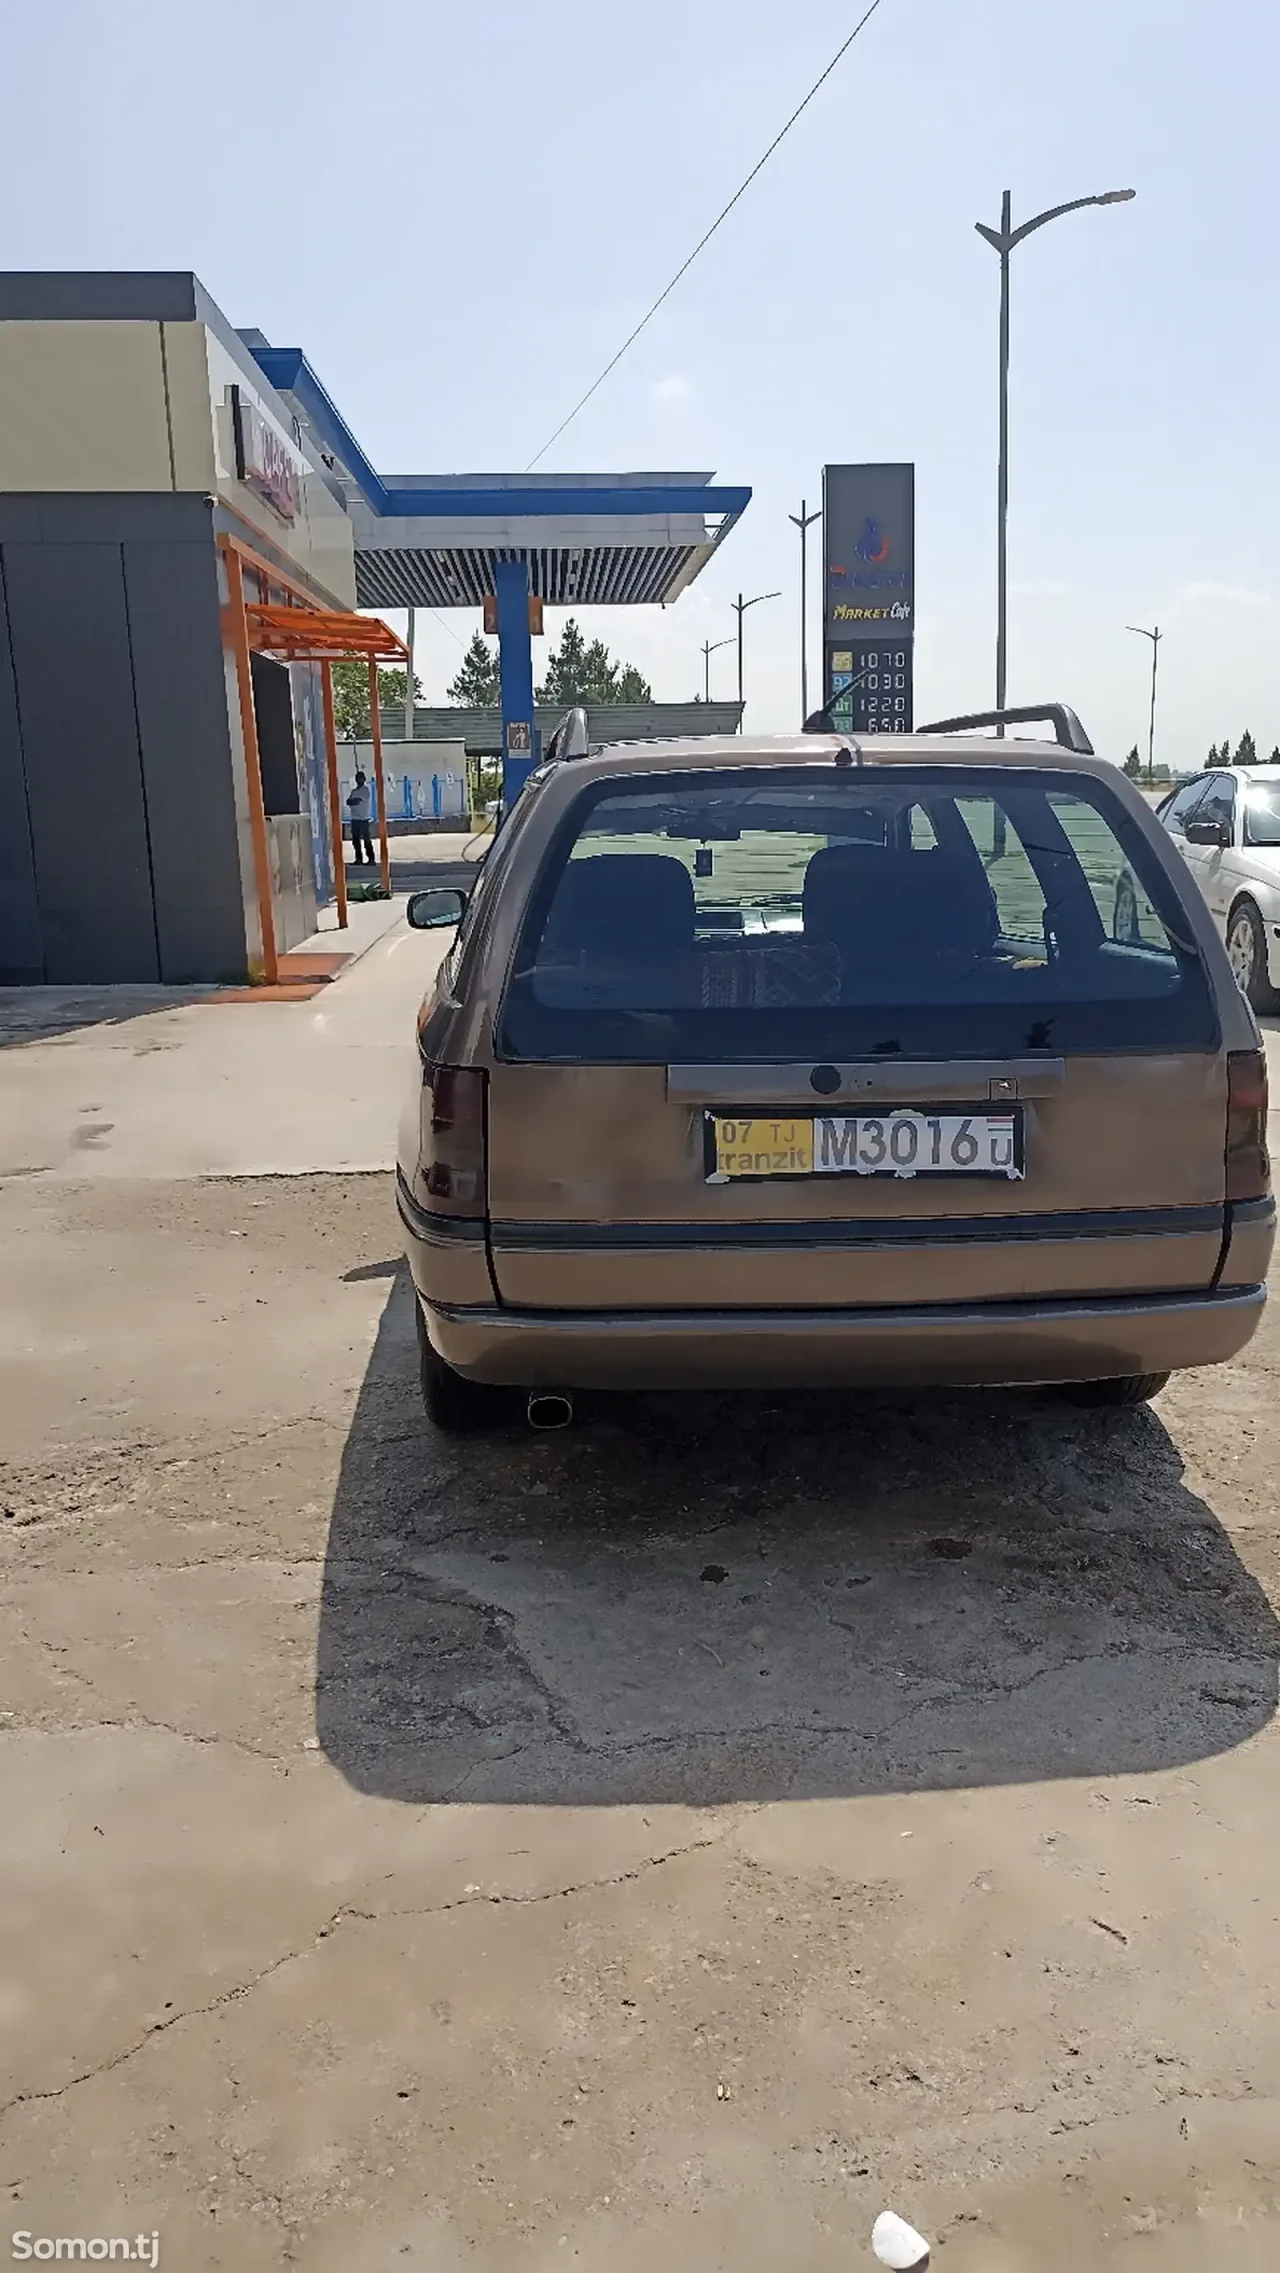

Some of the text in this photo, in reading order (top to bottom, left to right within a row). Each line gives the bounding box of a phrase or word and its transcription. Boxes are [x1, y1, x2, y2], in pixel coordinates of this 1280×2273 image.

[833, 604, 890, 620] MARKET
[722, 1121, 796, 1143] 07 TJ
[821, 1119, 979, 1166] M3016
